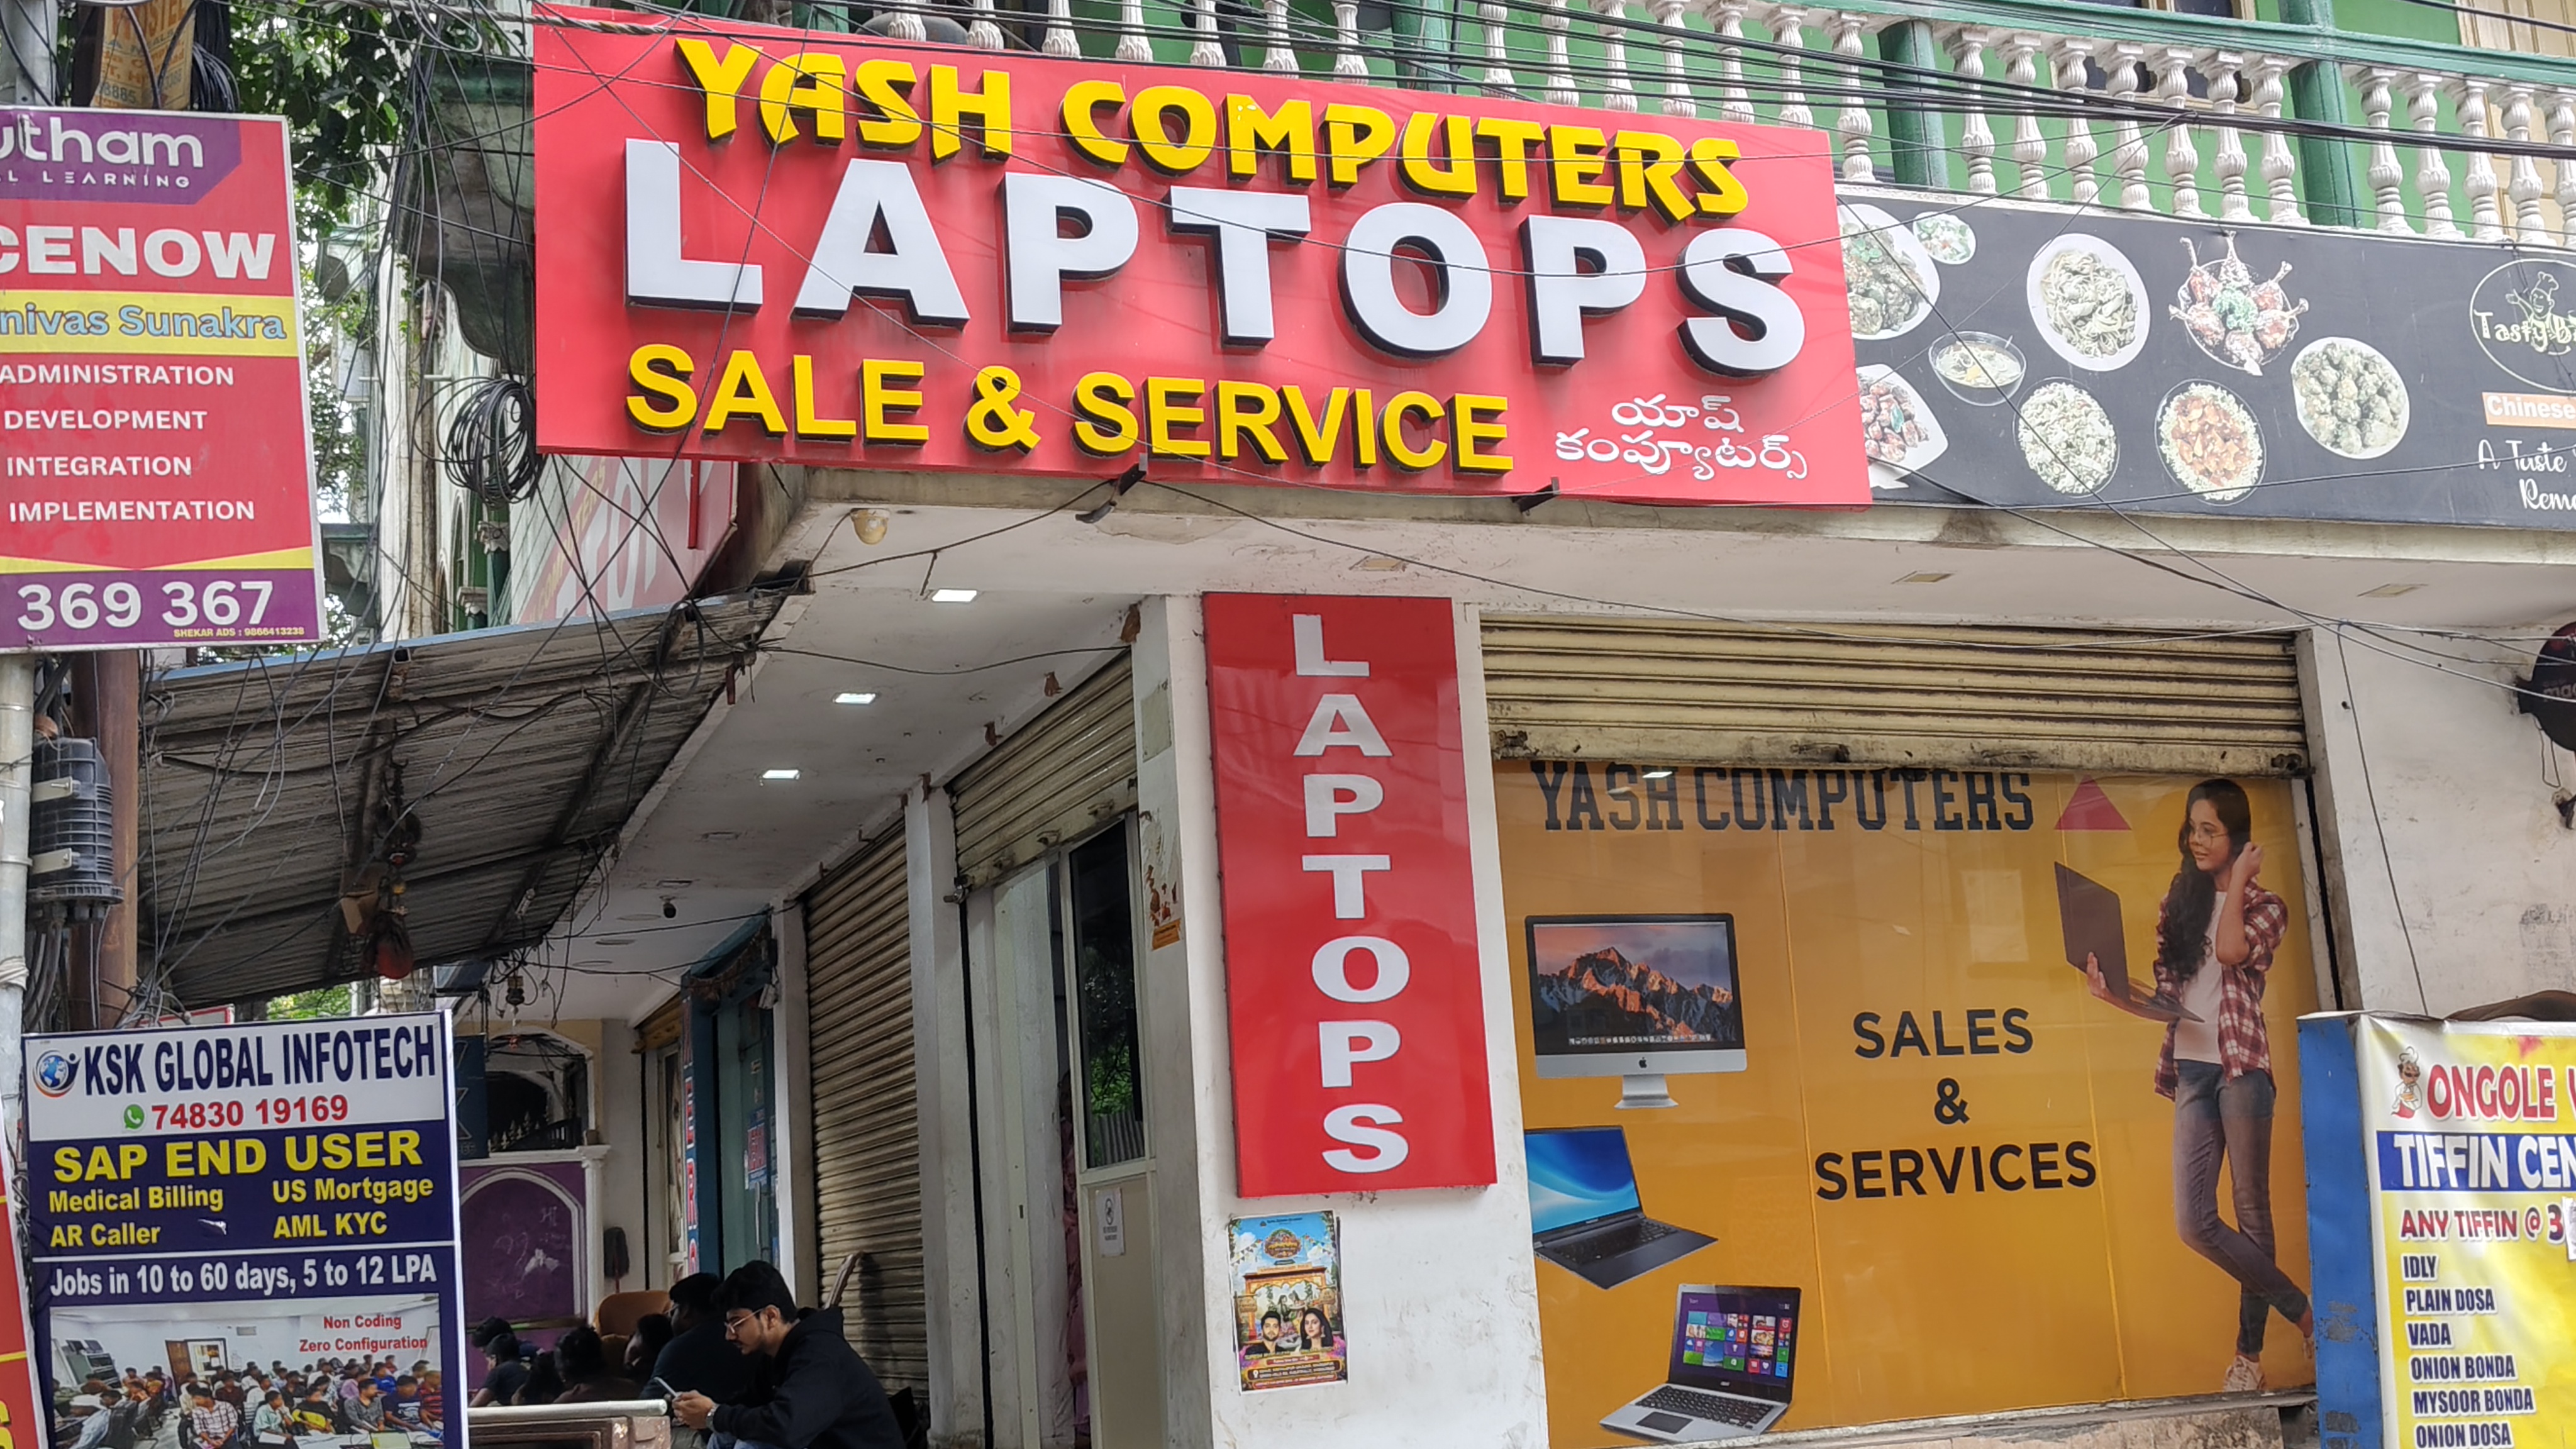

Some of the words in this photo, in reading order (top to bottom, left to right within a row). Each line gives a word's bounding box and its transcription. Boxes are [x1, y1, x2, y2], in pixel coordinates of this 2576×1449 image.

[675, 38, 1012, 164] YASH
[1060, 80, 1748, 224] COMPUTERS
[43, 170, 189, 187] LEARNING
[624, 138, 1805, 379] LAPTOPS
[119, 306, 287, 339] Sunakra
[0, 365, 233, 386] ADMINISTRATION
[4, 411, 207, 430] DEVELOPMENT
[625, 343, 930, 447] SALE
[963, 365, 1041, 454] &
[1072, 371, 1514, 475] SERVICE
[2487, 396, 2576, 421] Chinese
[7, 457, 191, 476] INTEGRATION
[2478, 438, 2501, 470] A
[2506, 440, 2567, 473] Taste
[9, 501, 255, 521] IMPLEMENTATION
[18, 582, 142, 630] 369
[161, 580, 273, 626] 367
[174, 628, 214, 638] SHEKAR
[216, 628, 236, 637] ADS
[1531, 760, 1684, 830] YASH
[1693, 767, 2035, 830] COMPUTERS
[1292, 613, 1410, 1174] LAPTOPS
[1853, 1008, 2033, 1058] SALES
[85, 1043, 146, 1096] KSK
[155, 1035, 273, 1093] GLOBAL
[282, 1024, 436, 1084] INFOTECH
[1934, 1078, 1970, 1124] &
[2428, 1064, 2555, 1119] ONGOLE
[152, 1101, 244, 1131] 74830
[256, 1094, 348, 1124] 19169
[53, 1144, 148, 1183] SAP
[165, 1139, 267, 1177] END
[285, 1130, 423, 1172] USER
[1815, 1141, 2096, 1200] SERVICES
[2394, 1133, 2509, 1188] TIFFIN
[50, 1189, 140, 1213] Medical
[148, 1184, 224, 1212] Billing
[273, 1180, 307, 1204] US
[316, 1175, 433, 1202] Mortgage
[50, 1226, 83, 1248] AR
[91, 1223, 160, 1246] Caller
[274, 1216, 328, 1240] AML
[336, 1211, 387, 1236] KYC
[2401, 1210, 2448, 1238] ANY
[2455, 1210, 2517, 1238] TIFFIN
[2525, 1208, 2541, 1238] @
[50, 1269, 103, 1297] Jobs
[109, 1267, 128, 1293] in
[137, 1264, 164, 1292] 10
[171, 1264, 194, 1292] to
[201, 1262, 228, 1291] 60
[235, 1260, 296, 1296] days,
[304, 1259, 316, 1287] 5
[325, 1258, 348, 1287] to
[356, 1255, 384, 1284] 12
[392, 1253, 436, 1284] LPA
[2404, 1255, 2437, 1278] IDLY
[2406, 1289, 2451, 1311] PLAIN
[2455, 1289, 2495, 1311] DOSA
[323, 1316, 350, 1330] Non
[355, 1314, 402, 1330] Coding
[2408, 1323, 2451, 1345] VADA
[299, 1339, 331, 1352] Zero
[335, 1335, 428, 1353] Configuration
[2411, 1357, 2460, 1380] ONION
[2465, 1355, 2516, 1379] BONDA
[2413, 1391, 2480, 1414] MYSOOR
[2484, 1389, 2534, 1413] BONDA
[2416, 1425, 2466, 1448] ONION
[2470, 1423, 2511, 1445] DOSA
